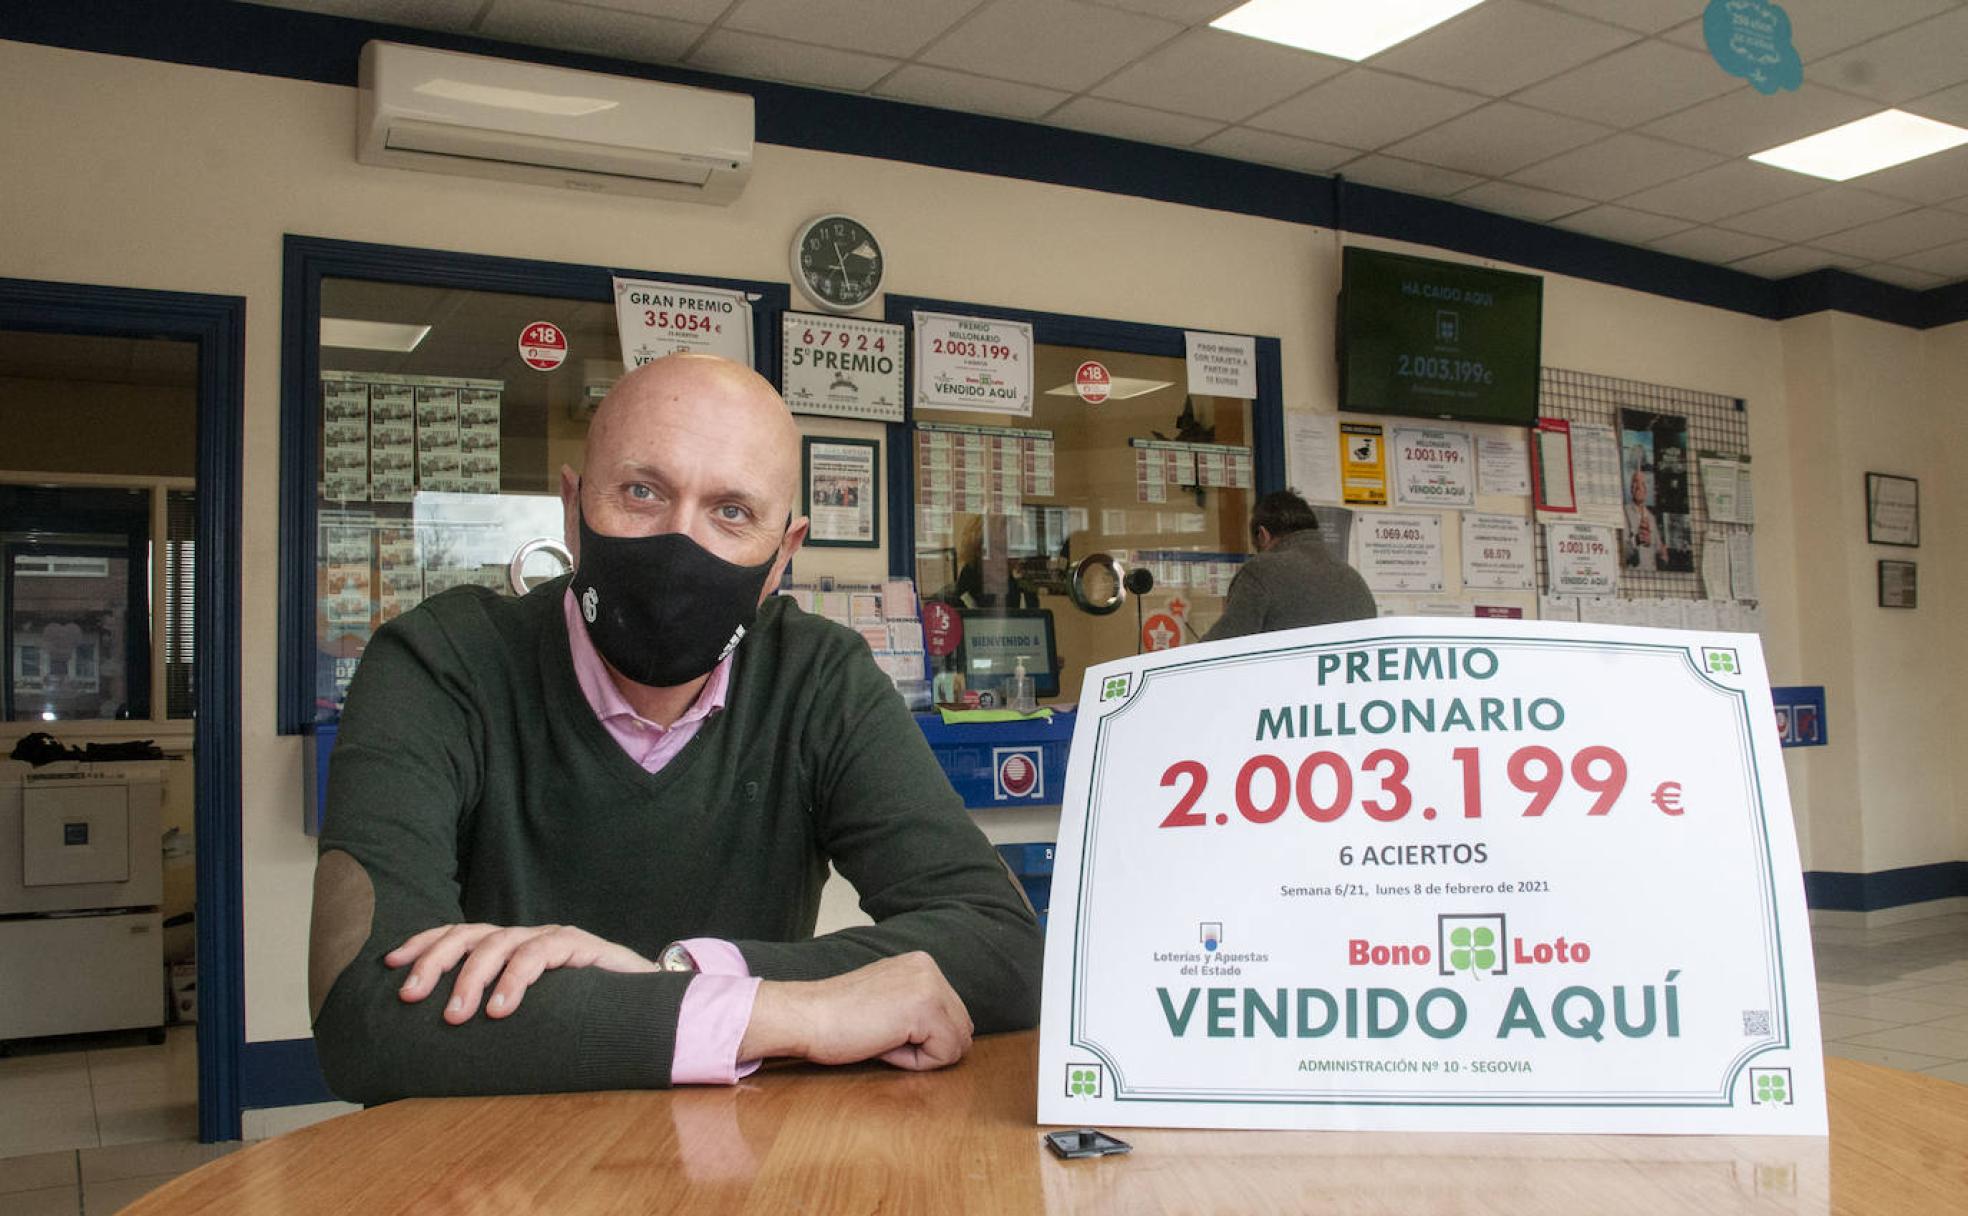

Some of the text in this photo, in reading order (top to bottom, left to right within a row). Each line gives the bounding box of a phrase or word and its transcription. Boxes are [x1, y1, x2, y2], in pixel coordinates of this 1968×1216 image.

[630, 292, 733, 314] GRAN PREMIO
[644, 310, 712, 333] 35.054
[530, 327, 557, 343] +18
[933, 338, 1010, 360] 2.003.199
[813, 349, 893, 375] PREMIO
[935, 382, 985, 396] VENDIDO
[1317, 646, 1499, 686] PREMIO
[1255, 697, 1565, 741] MILLONARIO
[1158, 745, 1685, 829] 2.003.199 €
[1339, 843, 1488, 866] 6 ACIERTOS
[1280, 880, 1550, 898] Semana 6/21, lunes 8 de febrero de 2021
[1204, 953, 1212, 964] y
[1215, 951, 1269, 964] Apuestas
[1348, 936, 1591, 966] Bono Loto
[1180, 964, 1242, 977] del Estado
[1155, 969, 1682, 1043] VENDIDO AQUÍ
[1297, 1057, 1418, 1074] ADMINISTRACIÓN
[1443, 1059, 1459, 1073] 10
[1471, 1059, 1533, 1074] SEGOVIA
